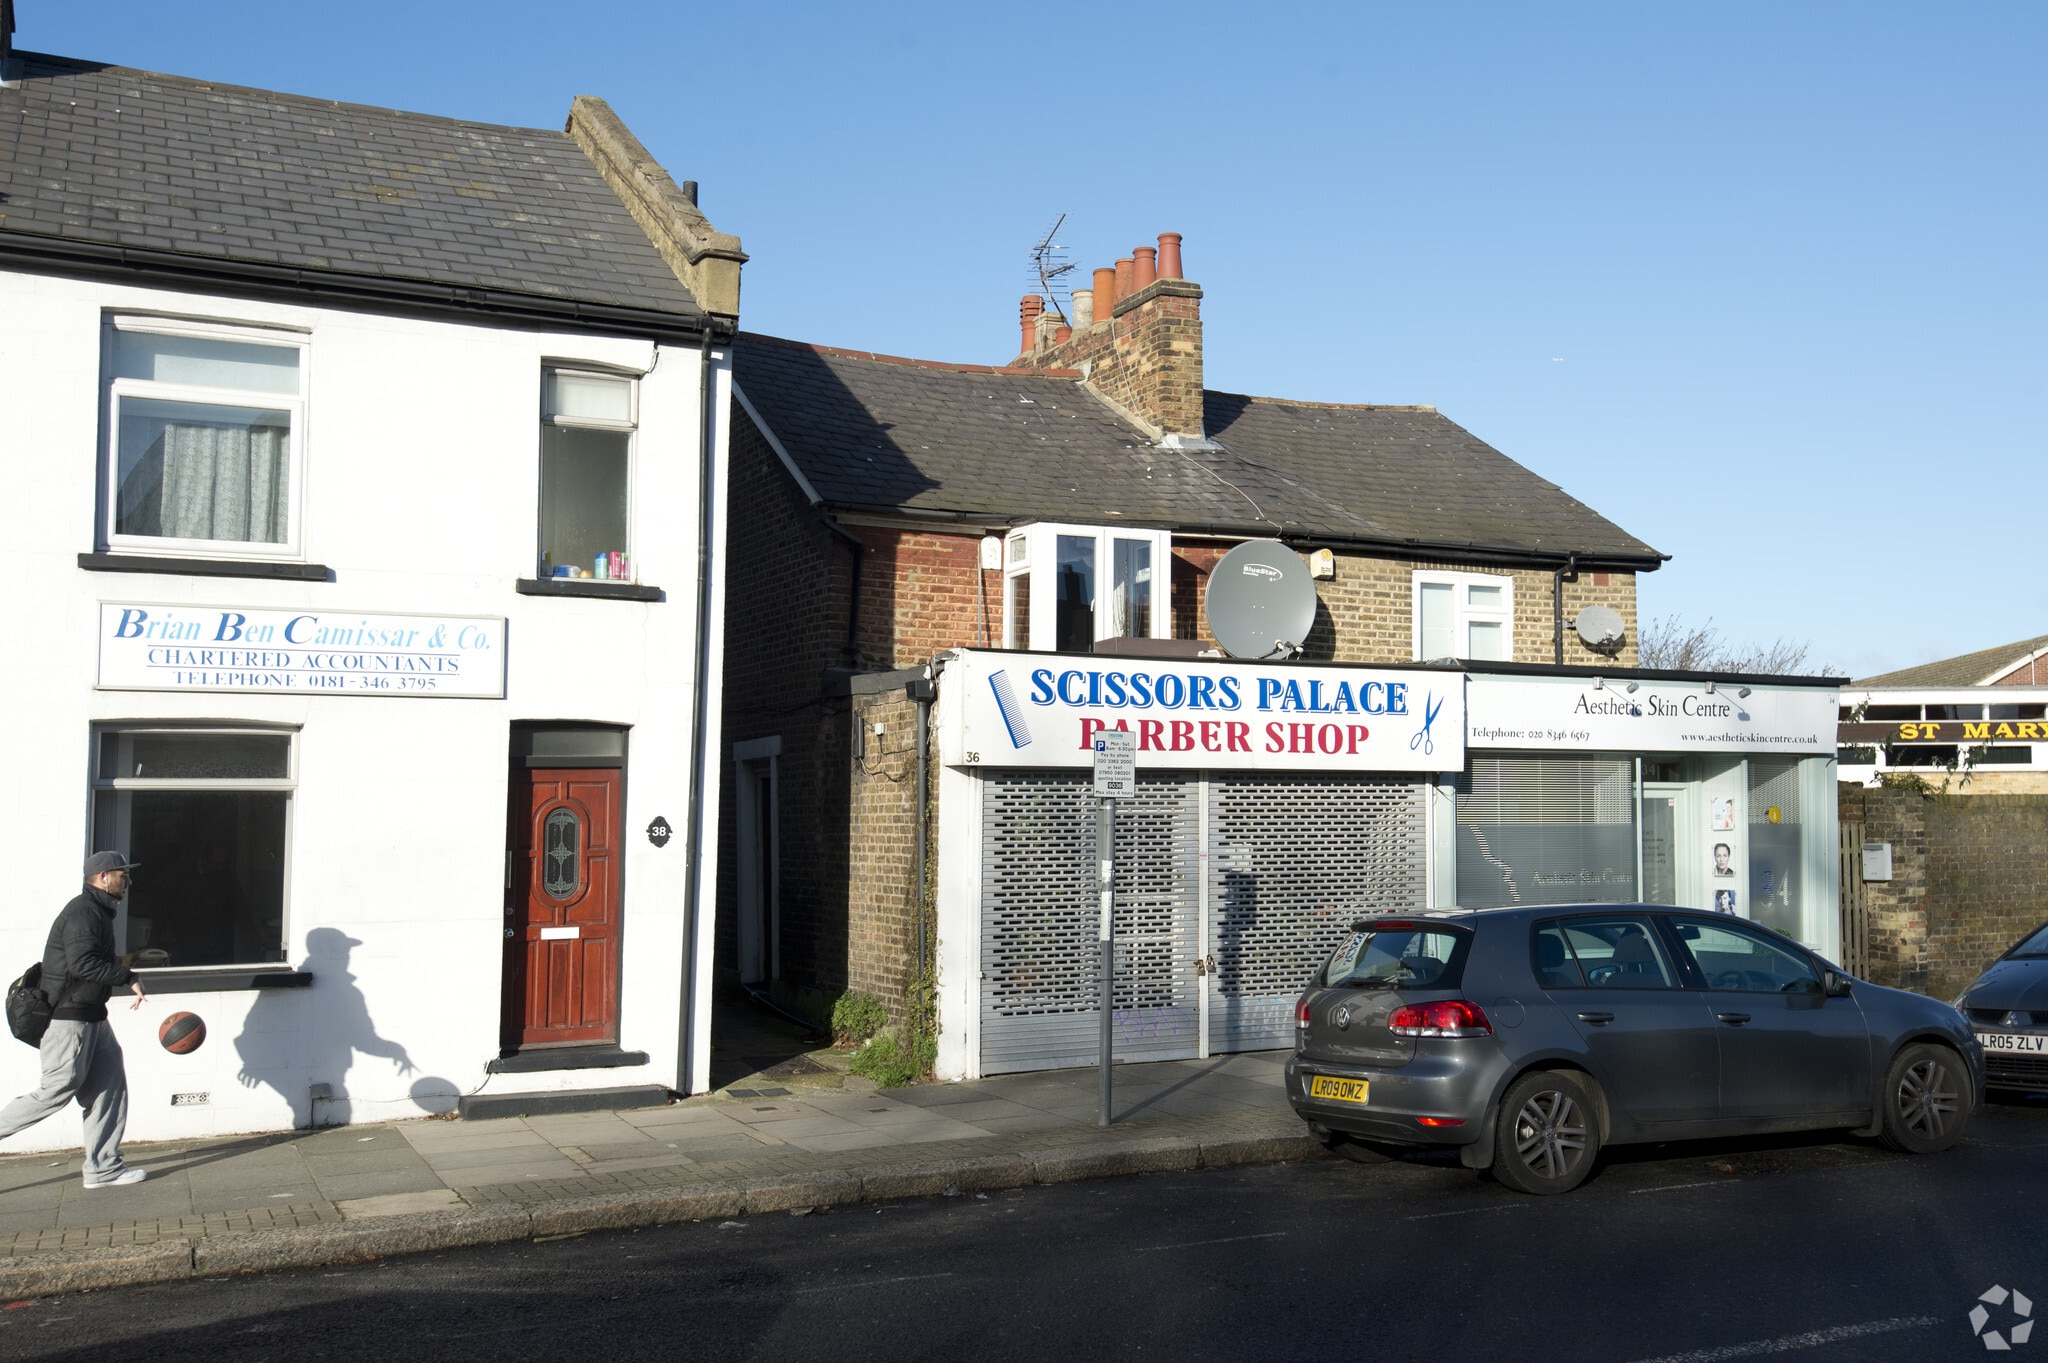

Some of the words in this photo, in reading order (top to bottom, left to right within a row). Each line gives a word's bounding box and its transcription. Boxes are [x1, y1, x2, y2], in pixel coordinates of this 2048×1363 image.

[112, 608, 201, 641] Brian
[212, 612, 275, 643] Ben
[284, 615, 419, 648] Camissar
[428, 623, 447, 649] &
[458, 625, 491, 650] Co.
[148, 649, 291, 668] CHARTERED
[302, 654, 459, 673] ACCOUNTANTS
[172, 671, 297, 687] TELEPHONE
[397, 677, 436, 691] 3795
[1031, 668, 1241, 711] SCISSORS
[1256, 678, 1408, 715] PALACE
[1574, 693, 1643, 716] Aesthetic
[1647, 694, 1678, 716] Skin
[1682, 695, 1731, 718] Centre
[1265, 721, 1369, 755] SHOP
[1471, 727, 1525, 740] Telephone:
[1547, 729, 1567, 741] 8346
[1570, 731, 1590, 741] 6567
[1681, 733, 1818, 744] www.aestheticskincentre.co.uk
[1899, 723, 1941, 740] ST
[966, 751, 980, 763] 36
[652, 826, 666, 836] 38
[1982, 1034, 2013, 1049] LR05
[2017, 1036, 2043, 1051] ZLV
